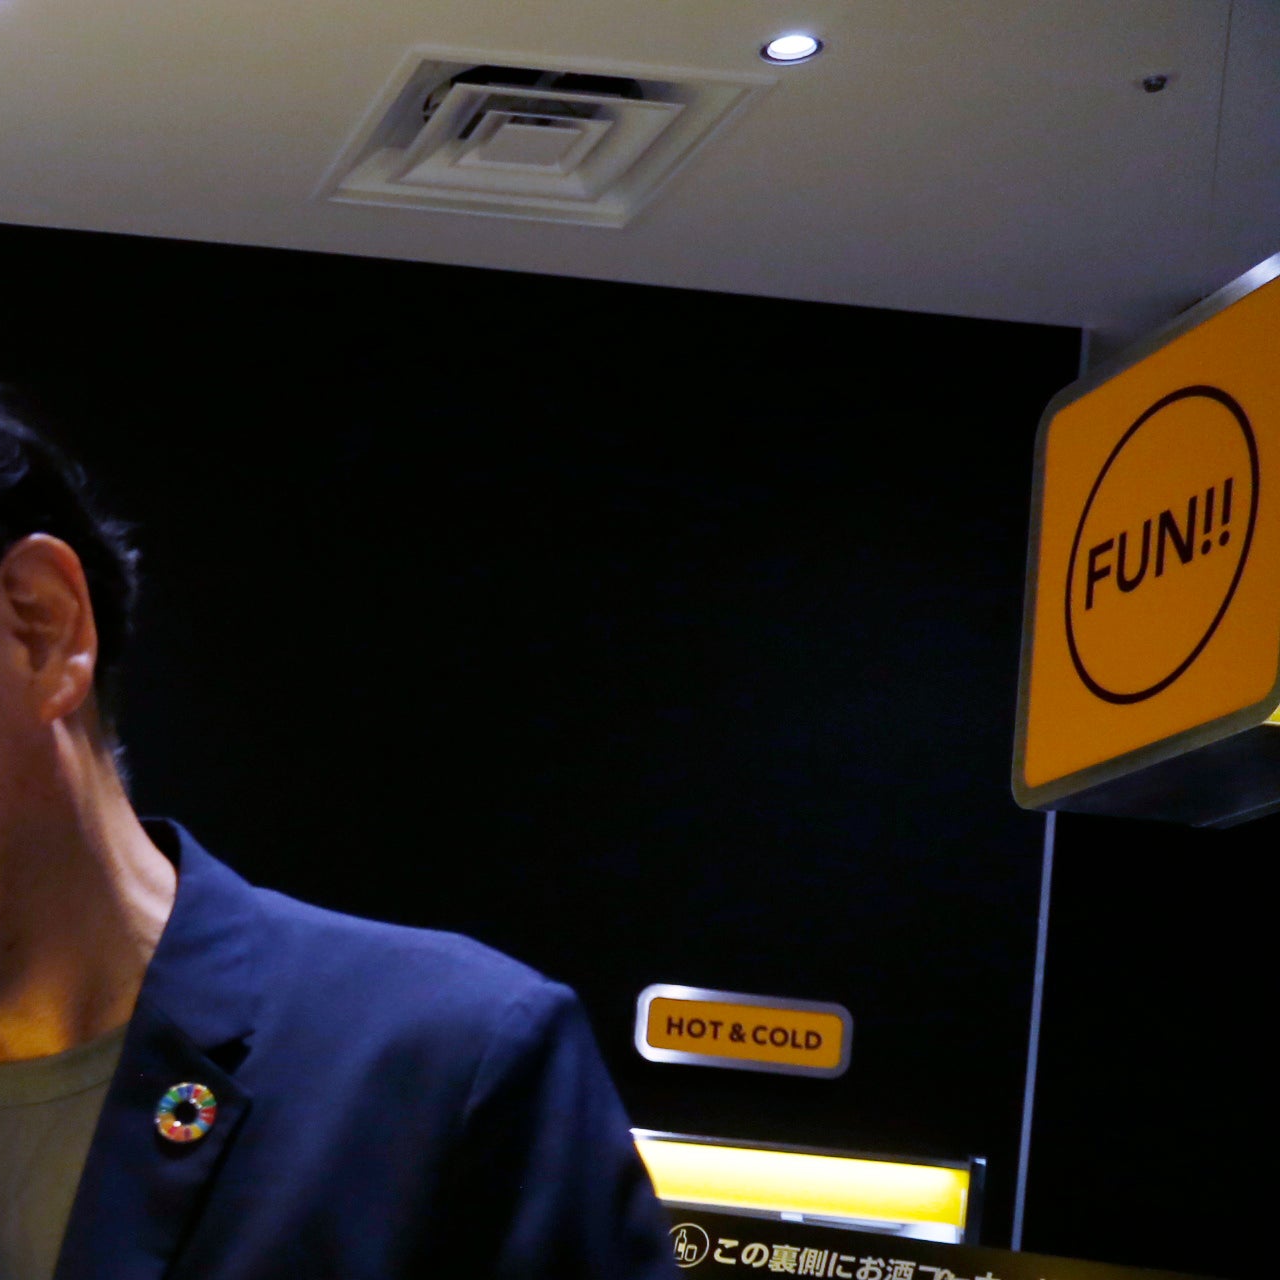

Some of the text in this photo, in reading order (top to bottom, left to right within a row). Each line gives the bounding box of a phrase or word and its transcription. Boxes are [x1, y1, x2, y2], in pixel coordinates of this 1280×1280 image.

[1085, 477, 1234, 610] FUN!!
[666, 1016, 823, 1050] HOT & COLD
